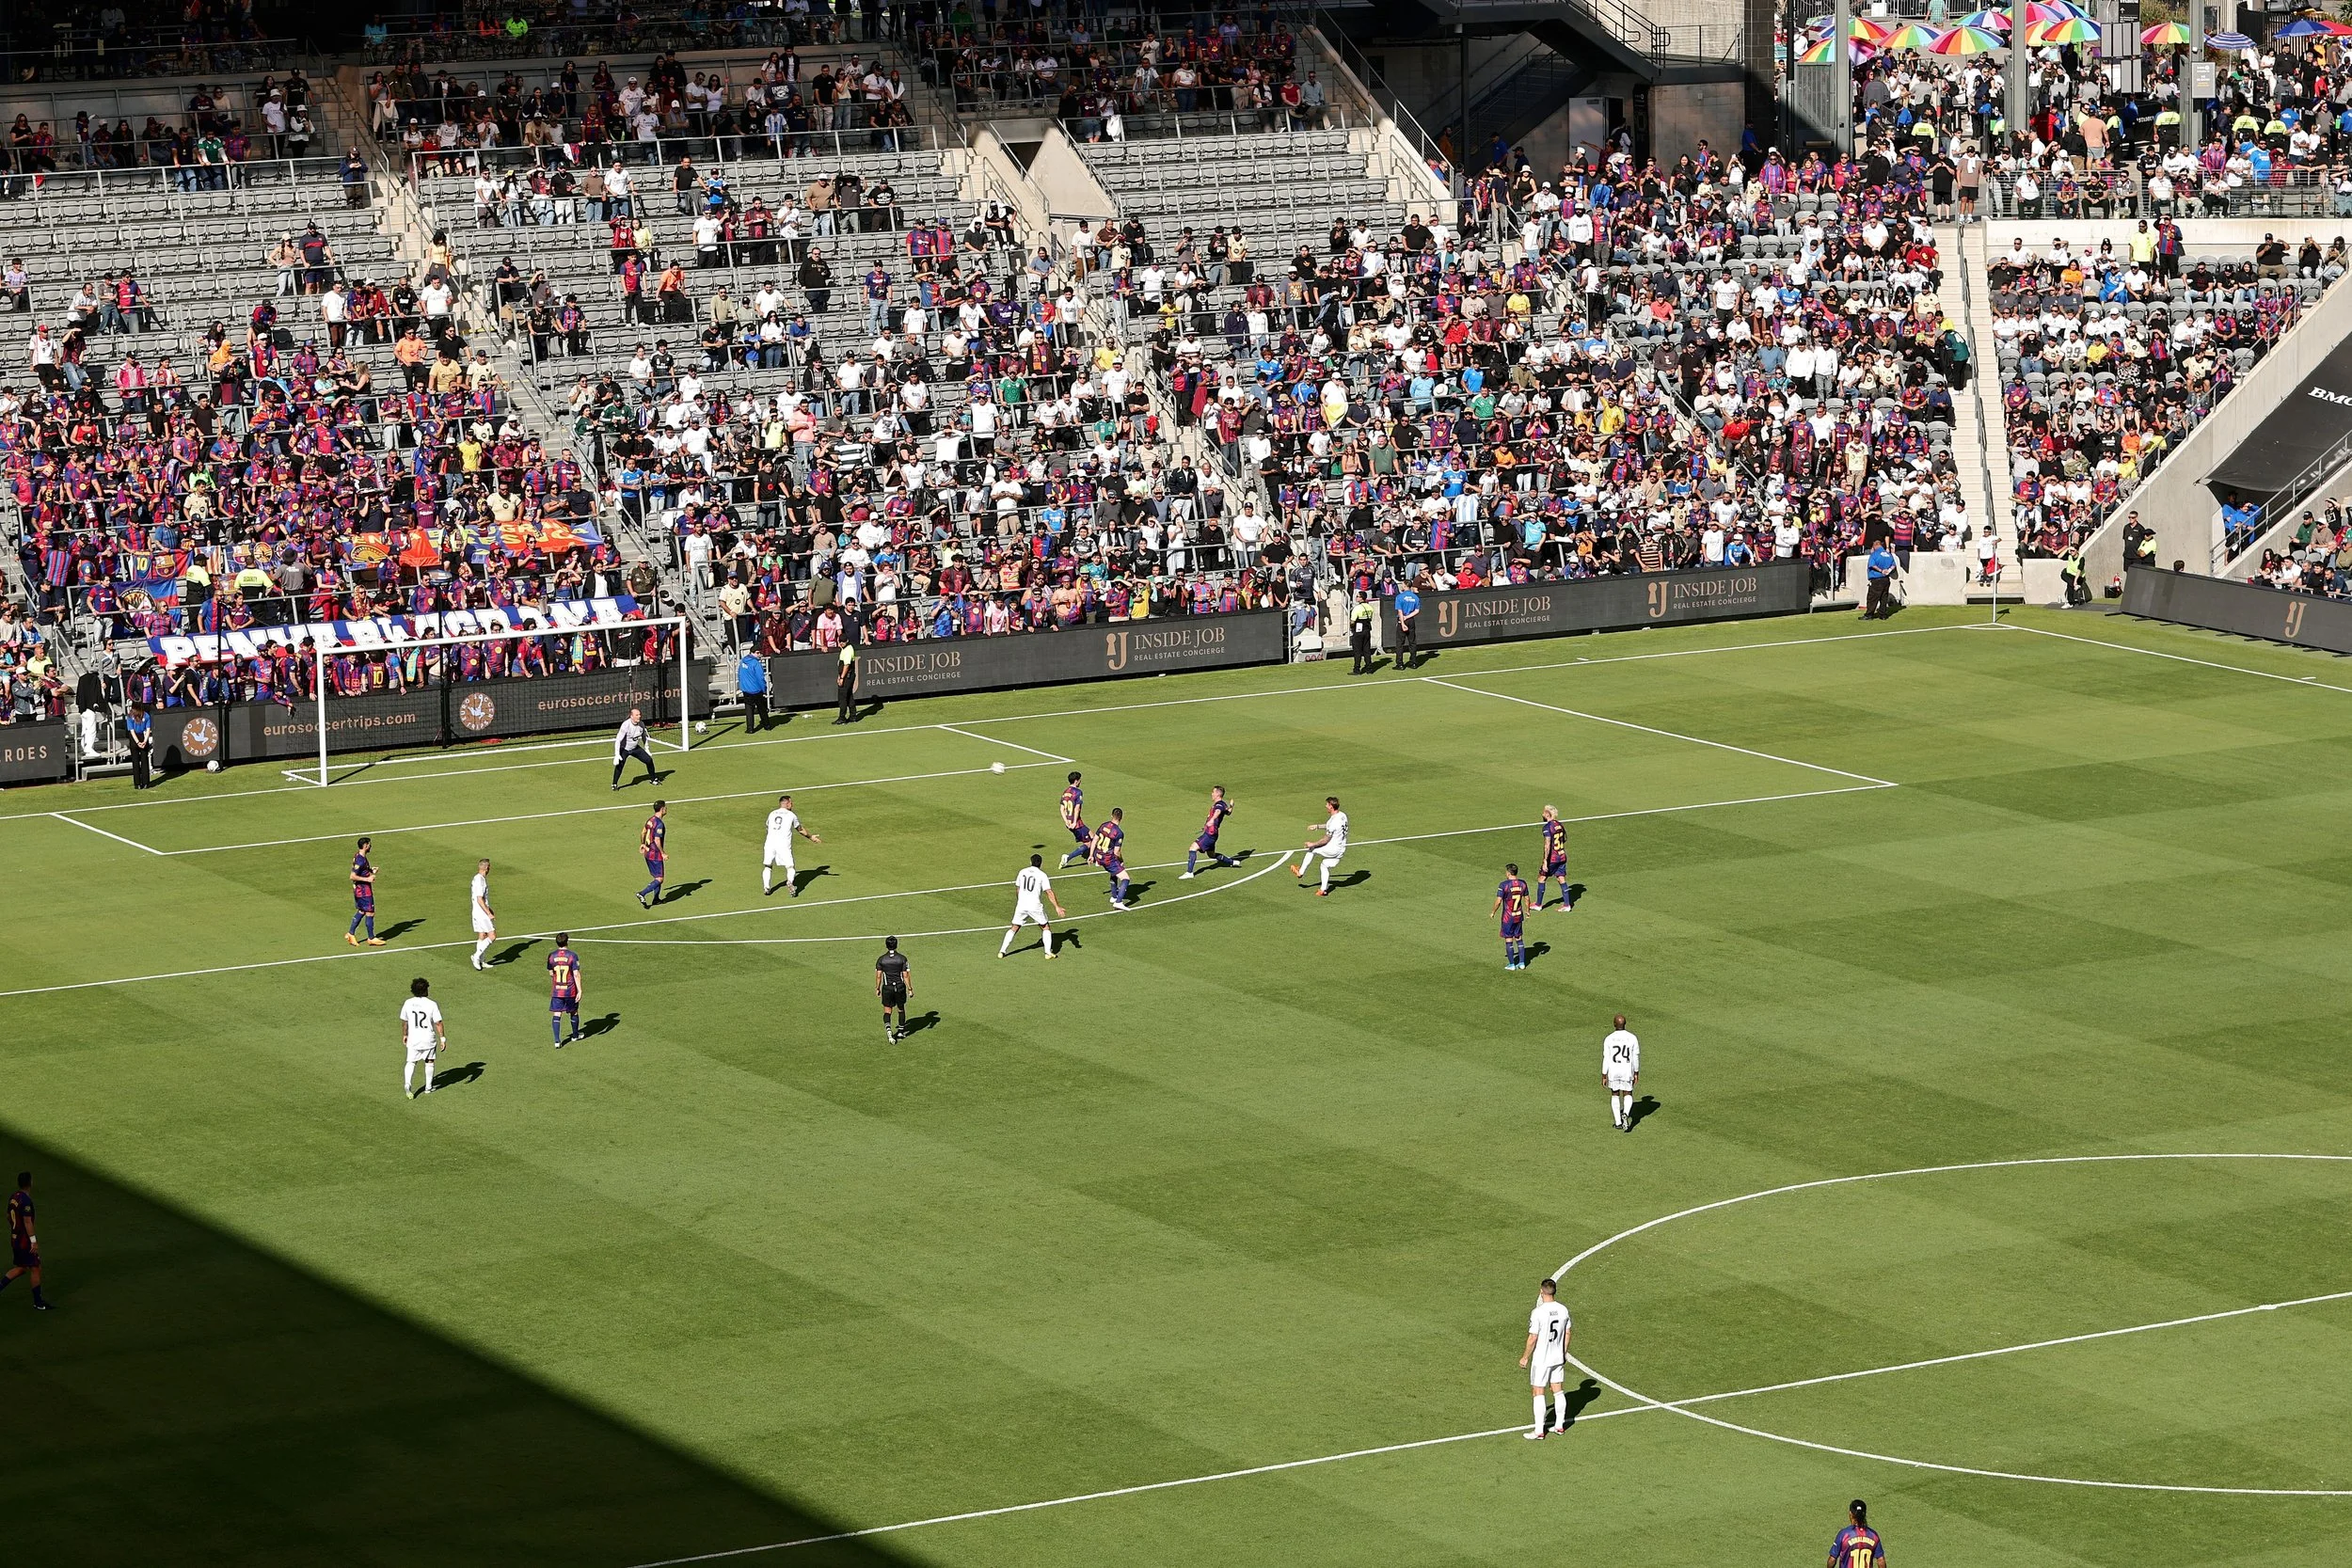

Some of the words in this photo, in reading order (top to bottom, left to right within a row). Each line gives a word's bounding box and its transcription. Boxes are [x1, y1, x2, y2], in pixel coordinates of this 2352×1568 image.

[1674, 579, 1726, 599] INSIDE
[1727, 577, 1756, 596] JOB
[1465, 598, 1518, 618] INSIDE
[1520, 595, 1551, 616] JOB
[1692, 599, 1715, 608] ESTATE
[1718, 595, 1757, 606] CONCIERGE
[1484, 618, 1508, 627] ESTATE
[1510, 614, 1550, 625] CONCIERGE
[1135, 629, 1192, 650] INSIDE
[1193, 626, 1225, 648] JOB
[1154, 651, 1181, 659] ESTATE
[1183, 646, 1225, 657] CONCIERGE
[866, 654, 927, 674] INSIDE
[929, 651, 961, 673] JOB
[373, 671, 384, 685] 10
[866, 678, 884, 687] REAL
[887, 675, 914, 685] ESTATE
[916, 671, 961, 682] CONCIERGE
[183, 723, 193, 747] EURO
[195, 719, 218, 744] SOCCER
[0, 746, 48, 763] ROES
[189, 745, 213, 755] TRIPS
[1097, 832, 1111, 854] 24
[1023, 874, 1036, 893] 10
[1511, 895, 1521, 911] 7
[553, 964, 570, 984] 17
[412, 1010, 428, 1029] 12
[1612, 1044, 1630, 1064] 24
[1549, 1319, 1559, 1343] 5
[1850, 1548, 1872, 1568] 10
